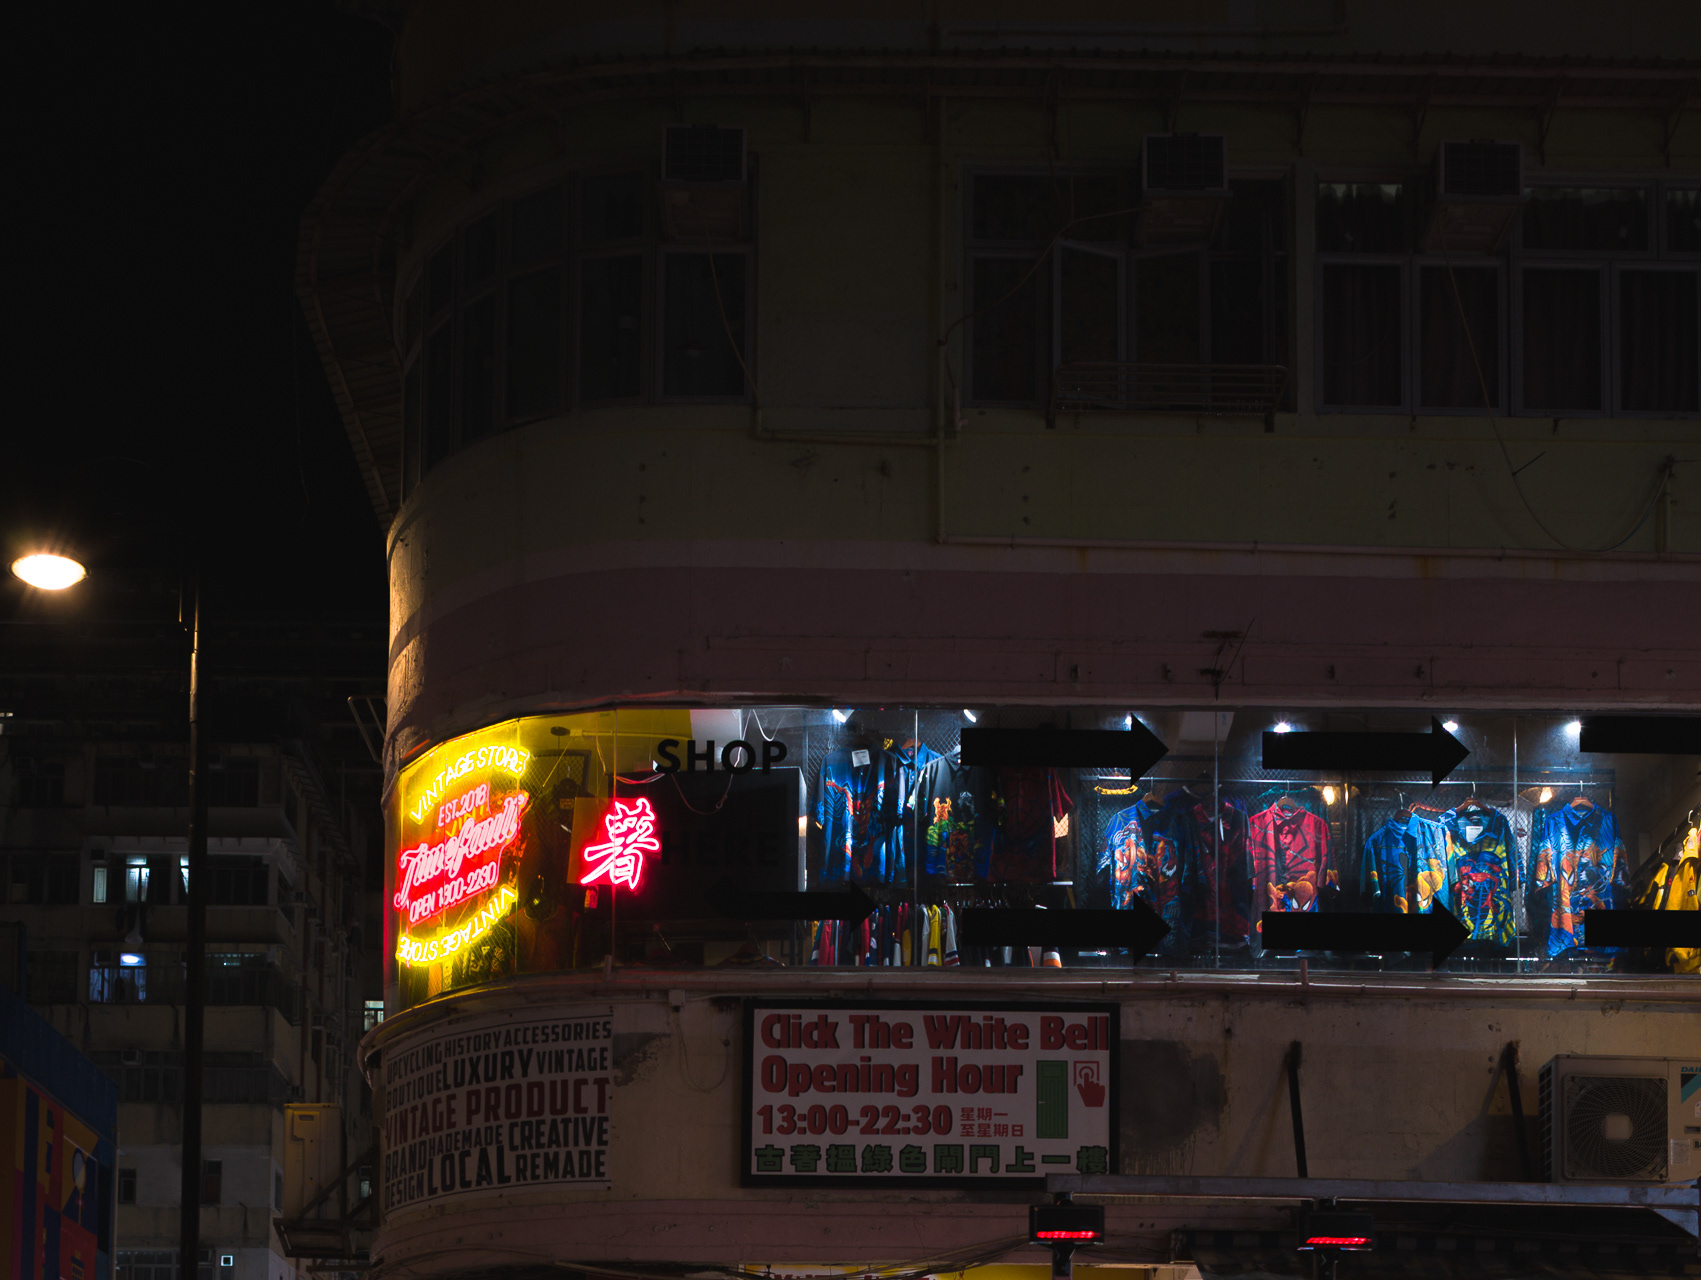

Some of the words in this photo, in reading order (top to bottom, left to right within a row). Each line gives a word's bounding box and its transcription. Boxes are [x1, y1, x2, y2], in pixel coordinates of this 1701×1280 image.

[410, 751, 476, 822] VINTAGE
[476, 745, 528, 776] STORE
[656, 738, 788, 775] SHOP
[409, 891, 437, 923] OPEN
[438, 861, 498, 909] 1300-2230
[441, 886, 516, 957] VINTAGE
[387, 1042, 442, 1085] UPCYCLING
[444, 1030, 502, 1058] HISTORY
[503, 1021, 612, 1048] ACCESSORIES
[760, 1013, 840, 1050] Click
[849, 1014, 914, 1050] The
[923, 1014, 1030, 1051] White
[1039, 1016, 1110, 1052] Bell
[386, 1069, 442, 1113] BOUTIQUE
[442, 1049, 534, 1091] LUXURY
[536, 1047, 608, 1075] VINTAGE
[760, 1054, 920, 1098] Opening
[931, 1056, 1024, 1095] Hour
[385, 1093, 457, 1150] VINTAGE
[466, 1077, 611, 1126] PRODUCT
[756, 1103, 954, 1137] 13:00-22:30
[960, 1107, 1009, 1122] 星期一
[960, 1123, 1024, 1138] 至星期日
[385, 1140, 428, 1183] BRAND
[508, 1116, 609, 1152] CREATIVE
[385, 1172, 424, 1211] DESIGN
[427, 1145, 512, 1196] LOCAL
[515, 1150, 606, 1183] REMADE
